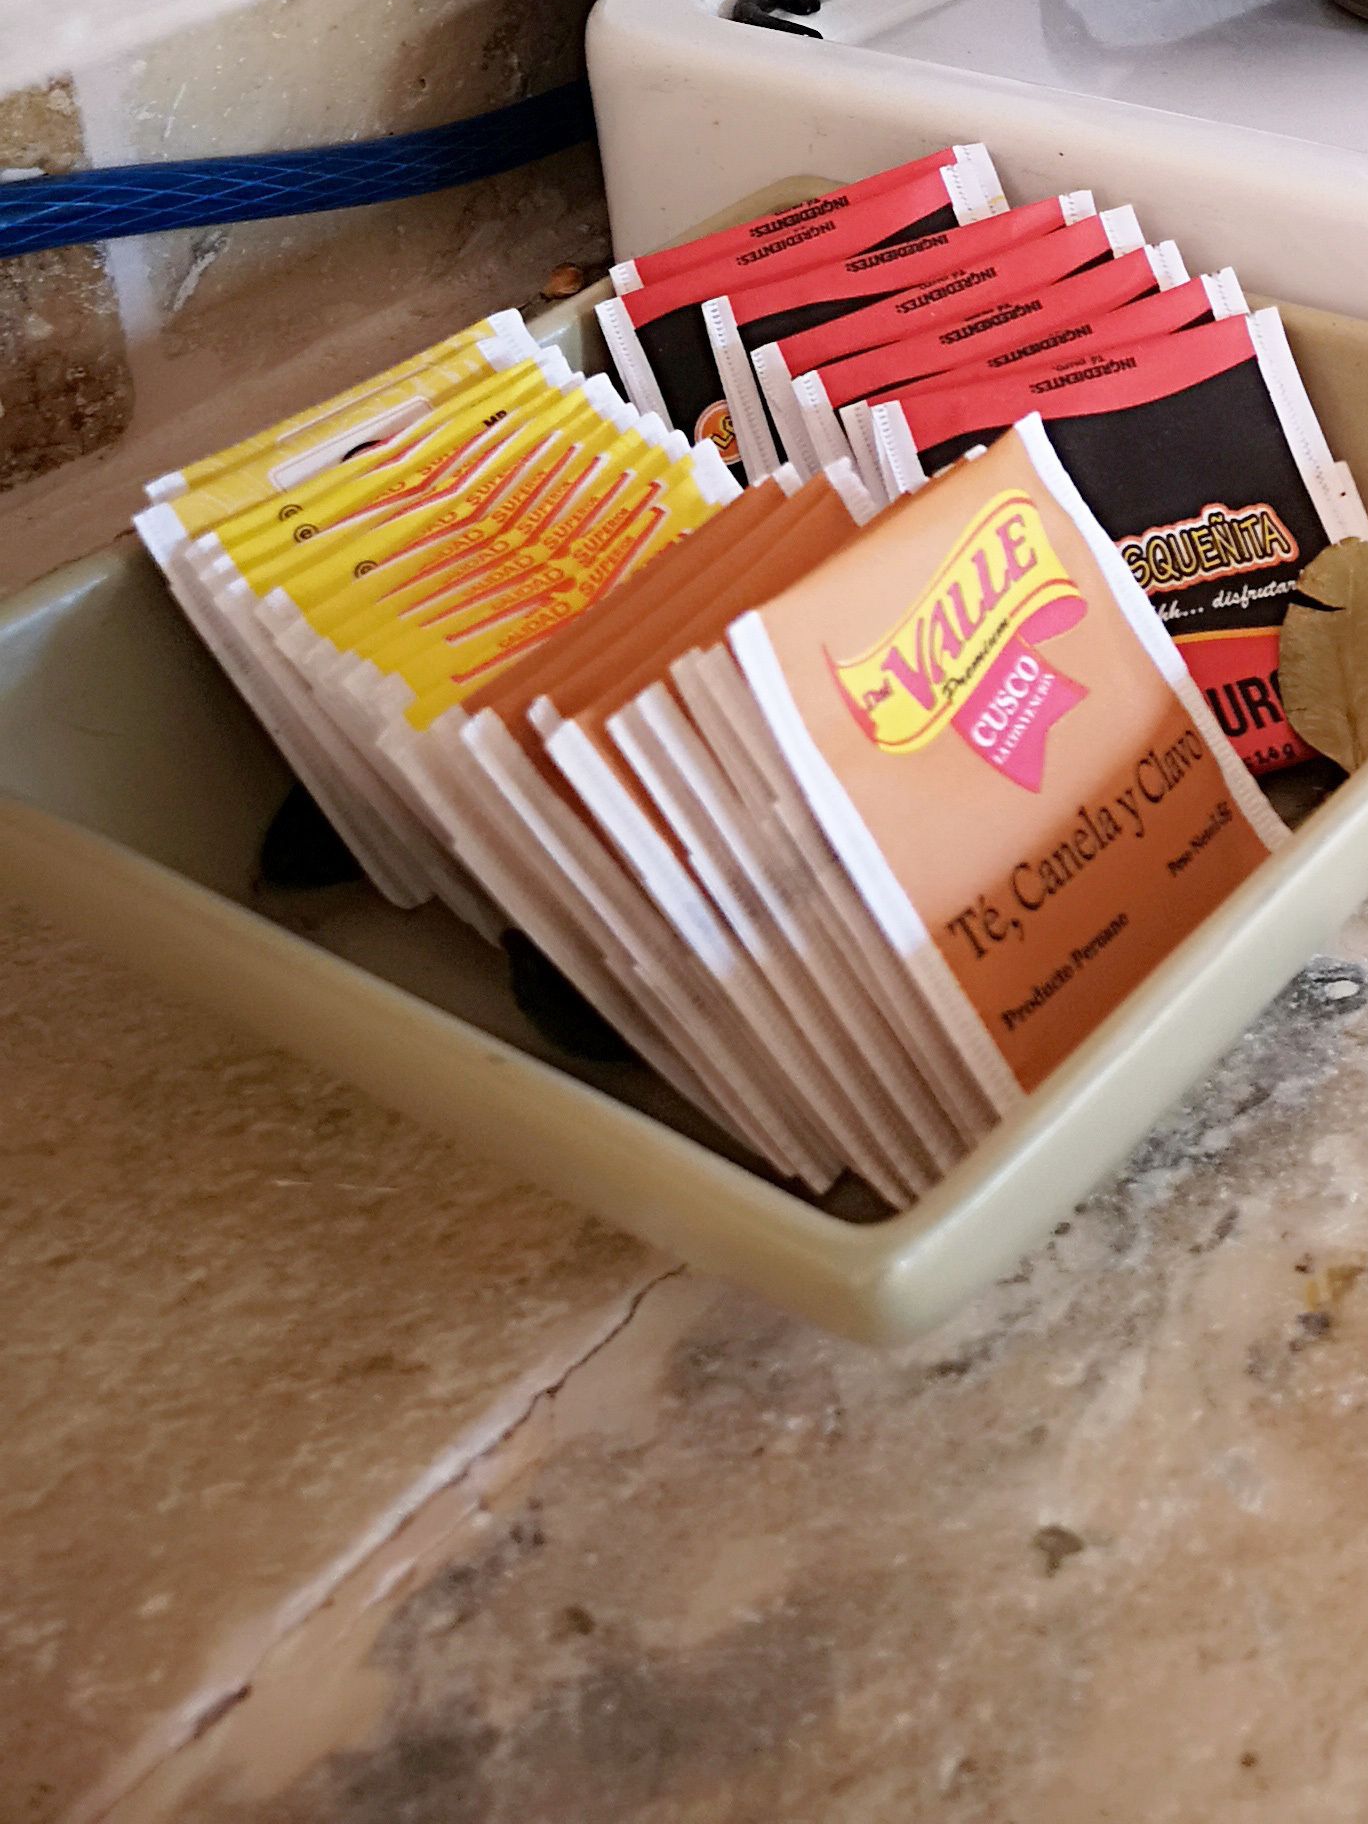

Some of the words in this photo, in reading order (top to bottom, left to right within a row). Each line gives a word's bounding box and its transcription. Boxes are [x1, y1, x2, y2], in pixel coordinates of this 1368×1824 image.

[1121, 511, 1291, 588] SQUEÑITA
[881, 513, 1037, 711] VALLE
[970, 655, 1040, 748] CUSCO
[1206, 668, 1283, 737] UR
[946, 895, 1025, 960] Té,
[1009, 806, 1122, 911] Canela
[1116, 789, 1144, 838] y
[1136, 730, 1204, 803] Clavo
